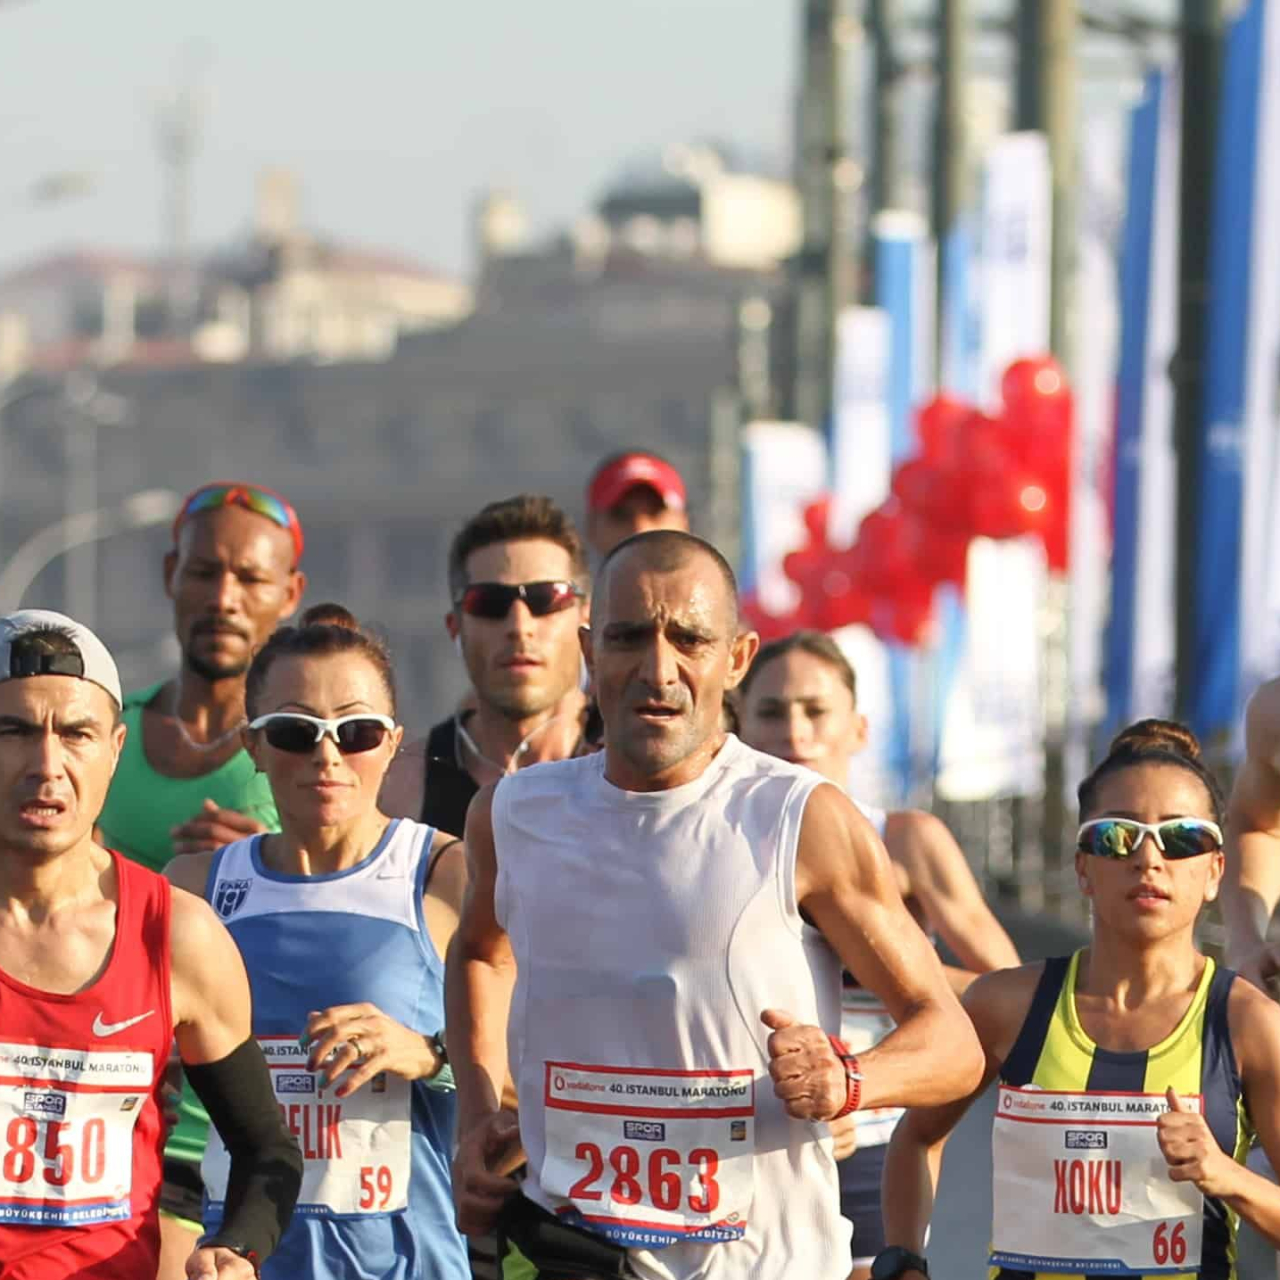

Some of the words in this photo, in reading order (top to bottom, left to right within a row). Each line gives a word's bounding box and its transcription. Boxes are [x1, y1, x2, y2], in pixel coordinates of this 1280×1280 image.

[626, 1122, 662, 1133] SPOR
[1067, 1131, 1105, 1142] SPOR
[360, 1166, 393, 1210] 59
[569, 1142, 720, 1213] 2863
[1054, 1159, 1123, 1215] XOKU
[1153, 1221, 1187, 1265] 66
